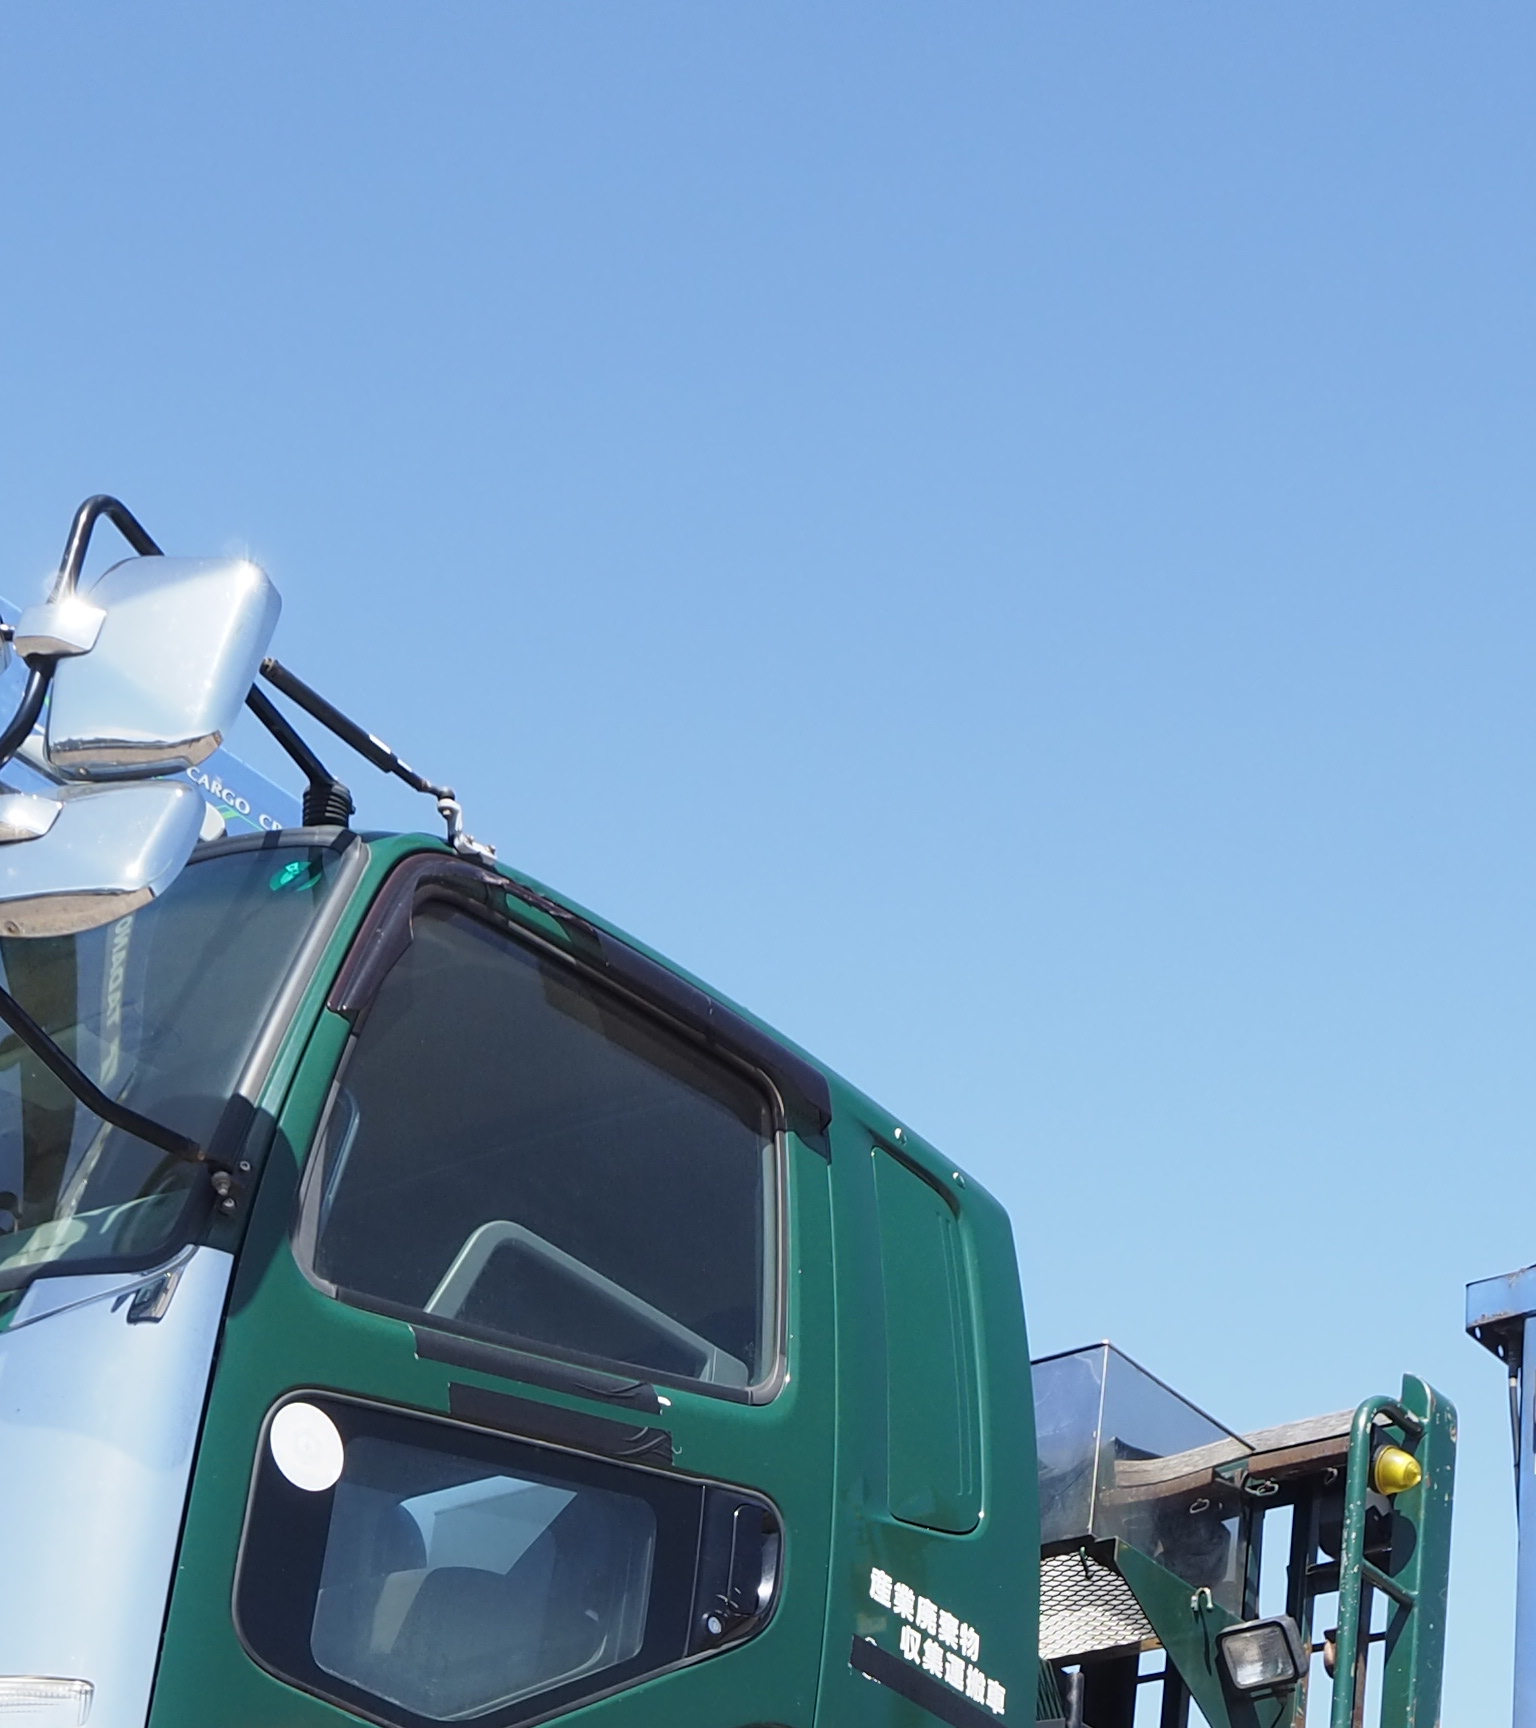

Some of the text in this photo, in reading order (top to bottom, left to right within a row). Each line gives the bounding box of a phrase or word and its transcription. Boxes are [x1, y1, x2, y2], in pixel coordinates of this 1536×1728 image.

[186, 766, 251, 815] CARGO
[869, 1567, 980, 1662] 産業廃棄物
[900, 1625, 1007, 1715] 収集運搬車
